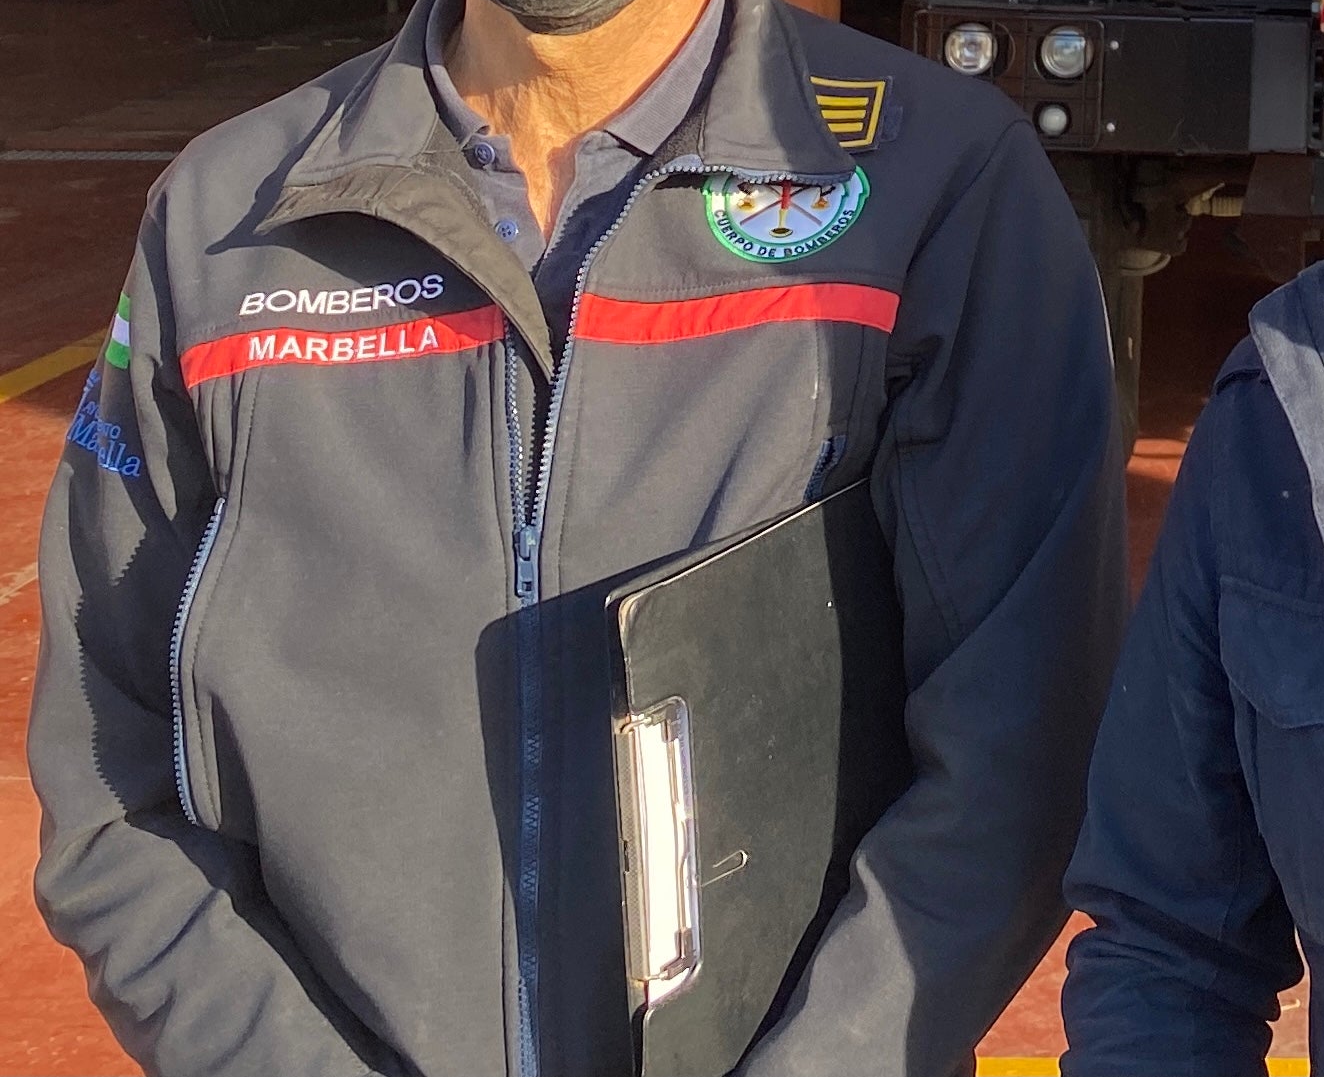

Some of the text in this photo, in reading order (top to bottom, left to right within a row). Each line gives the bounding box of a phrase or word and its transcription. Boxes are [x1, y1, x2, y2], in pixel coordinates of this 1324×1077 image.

[714, 208, 854, 258] CUERPO DE BOMBEROS
[239, 274, 444, 316] BOMBEROS
[248, 325, 439, 362] MARBELLA
